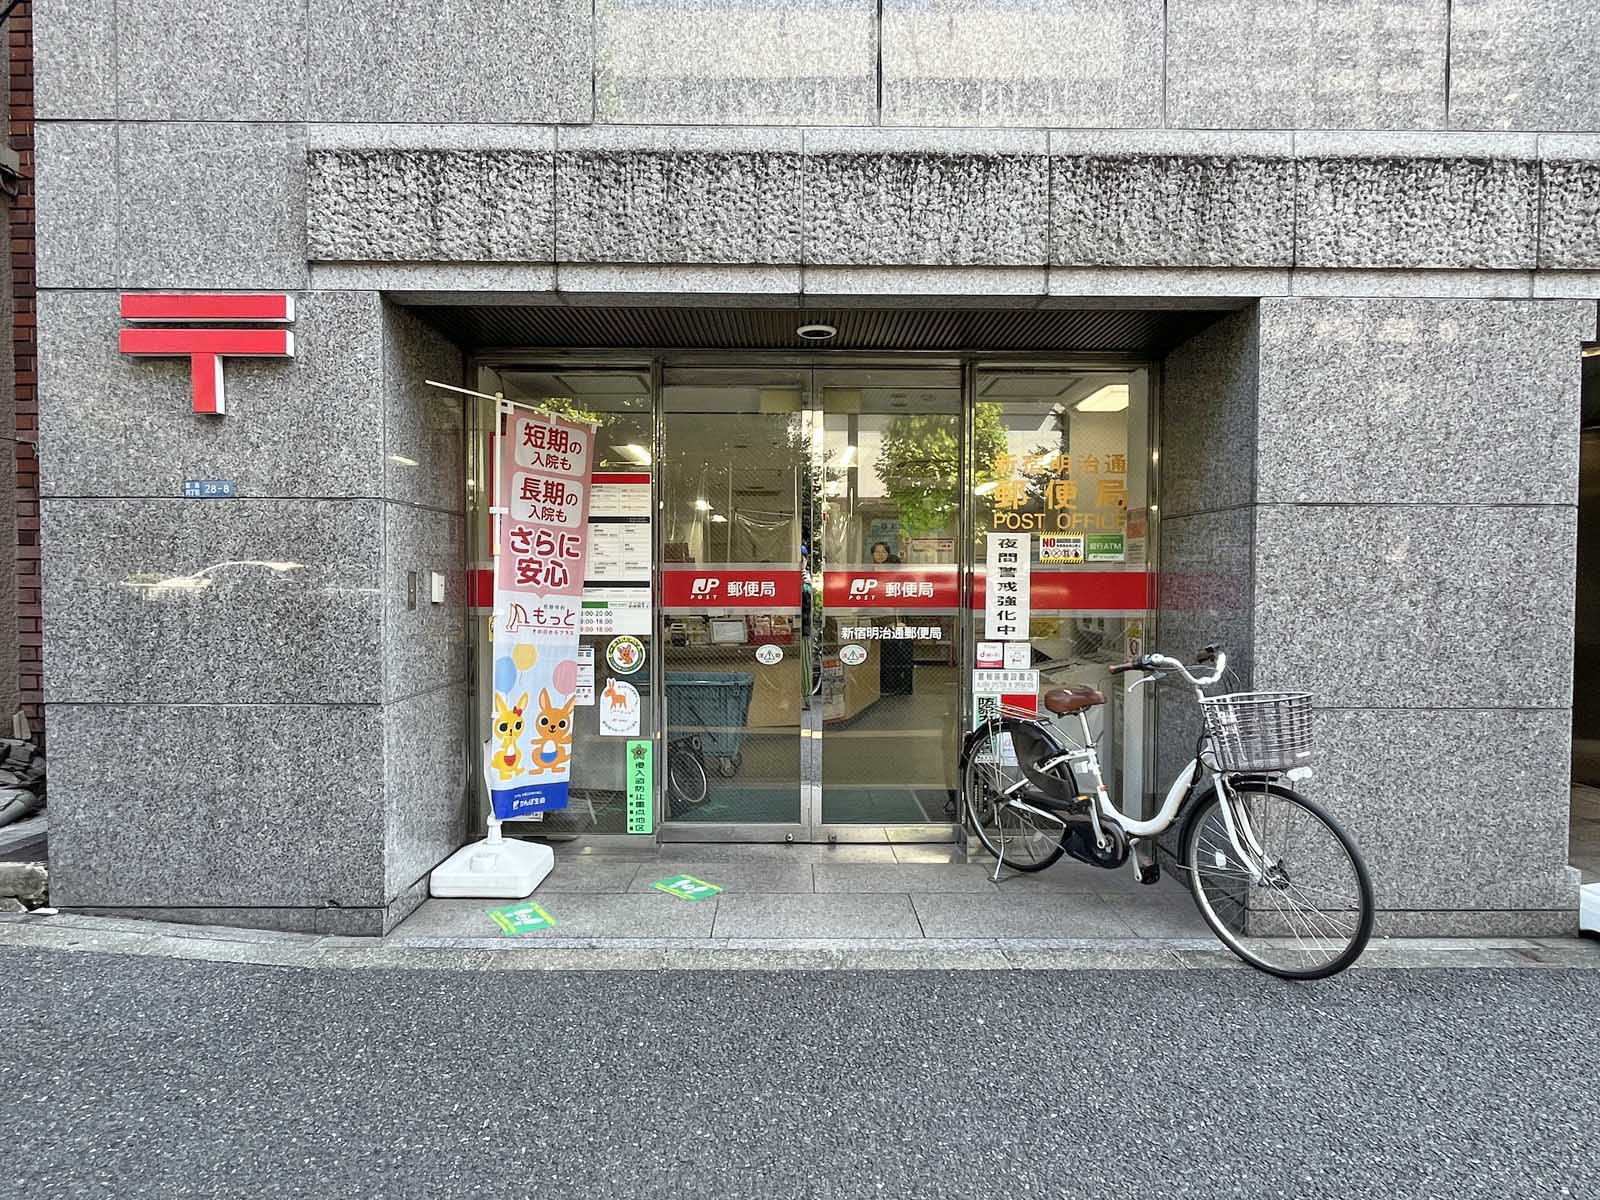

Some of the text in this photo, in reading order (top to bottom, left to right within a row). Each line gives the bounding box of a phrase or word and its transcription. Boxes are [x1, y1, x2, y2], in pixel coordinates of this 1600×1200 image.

[523, 423, 582, 455] 短期の
[530, 452, 573, 472] 入院も
[204, 484, 230, 494] 28-8
[519, 478, 578, 506] 長期の
[994, 479, 1128, 511] 郵便局
[527, 505, 568, 523] 入院も
[993, 513, 1127, 530] POST OFFICE
[510, 527, 581, 559] さらに
[1042, 537, 1056, 548] NO
[515, 557, 569, 587] 安心
[727, 580, 776, 598] 郵便局
[885, 581, 934, 598] 郵便局
[995, 538, 1019, 636] 夜間警戒強化中
[532, 607, 576, 626] もっと
[840, 626, 942, 641] 新宿明治通郵便局
